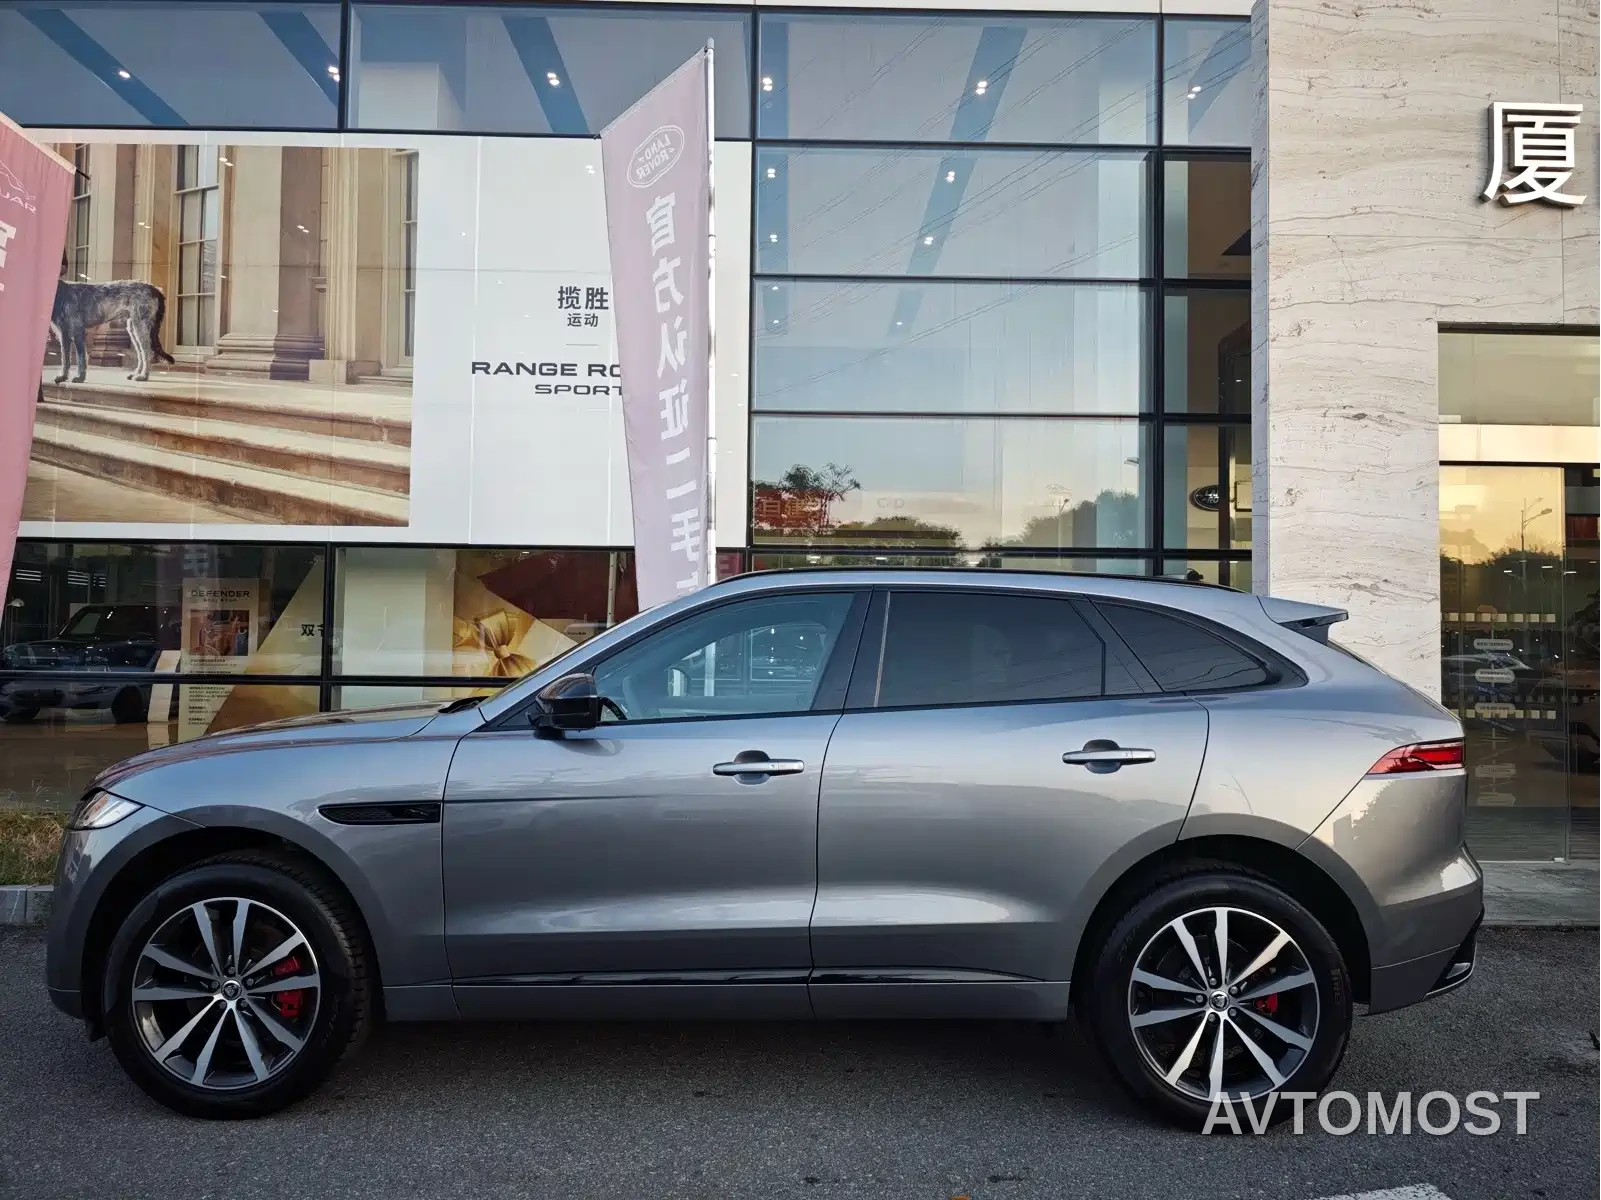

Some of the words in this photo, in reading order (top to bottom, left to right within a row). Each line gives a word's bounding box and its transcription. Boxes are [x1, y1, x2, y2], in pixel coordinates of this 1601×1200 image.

[1480, 101, 1588, 205] 厦
[0, 187, 37, 214] UAR
[557, 285, 609, 310] 揽胜
[567, 313, 599, 327] 运动
[471, 361, 578, 377] RANGE
[587, 363, 621, 378] RO
[535, 384, 623, 396] SPORT
[190, 590, 250, 598] DEFENDER
